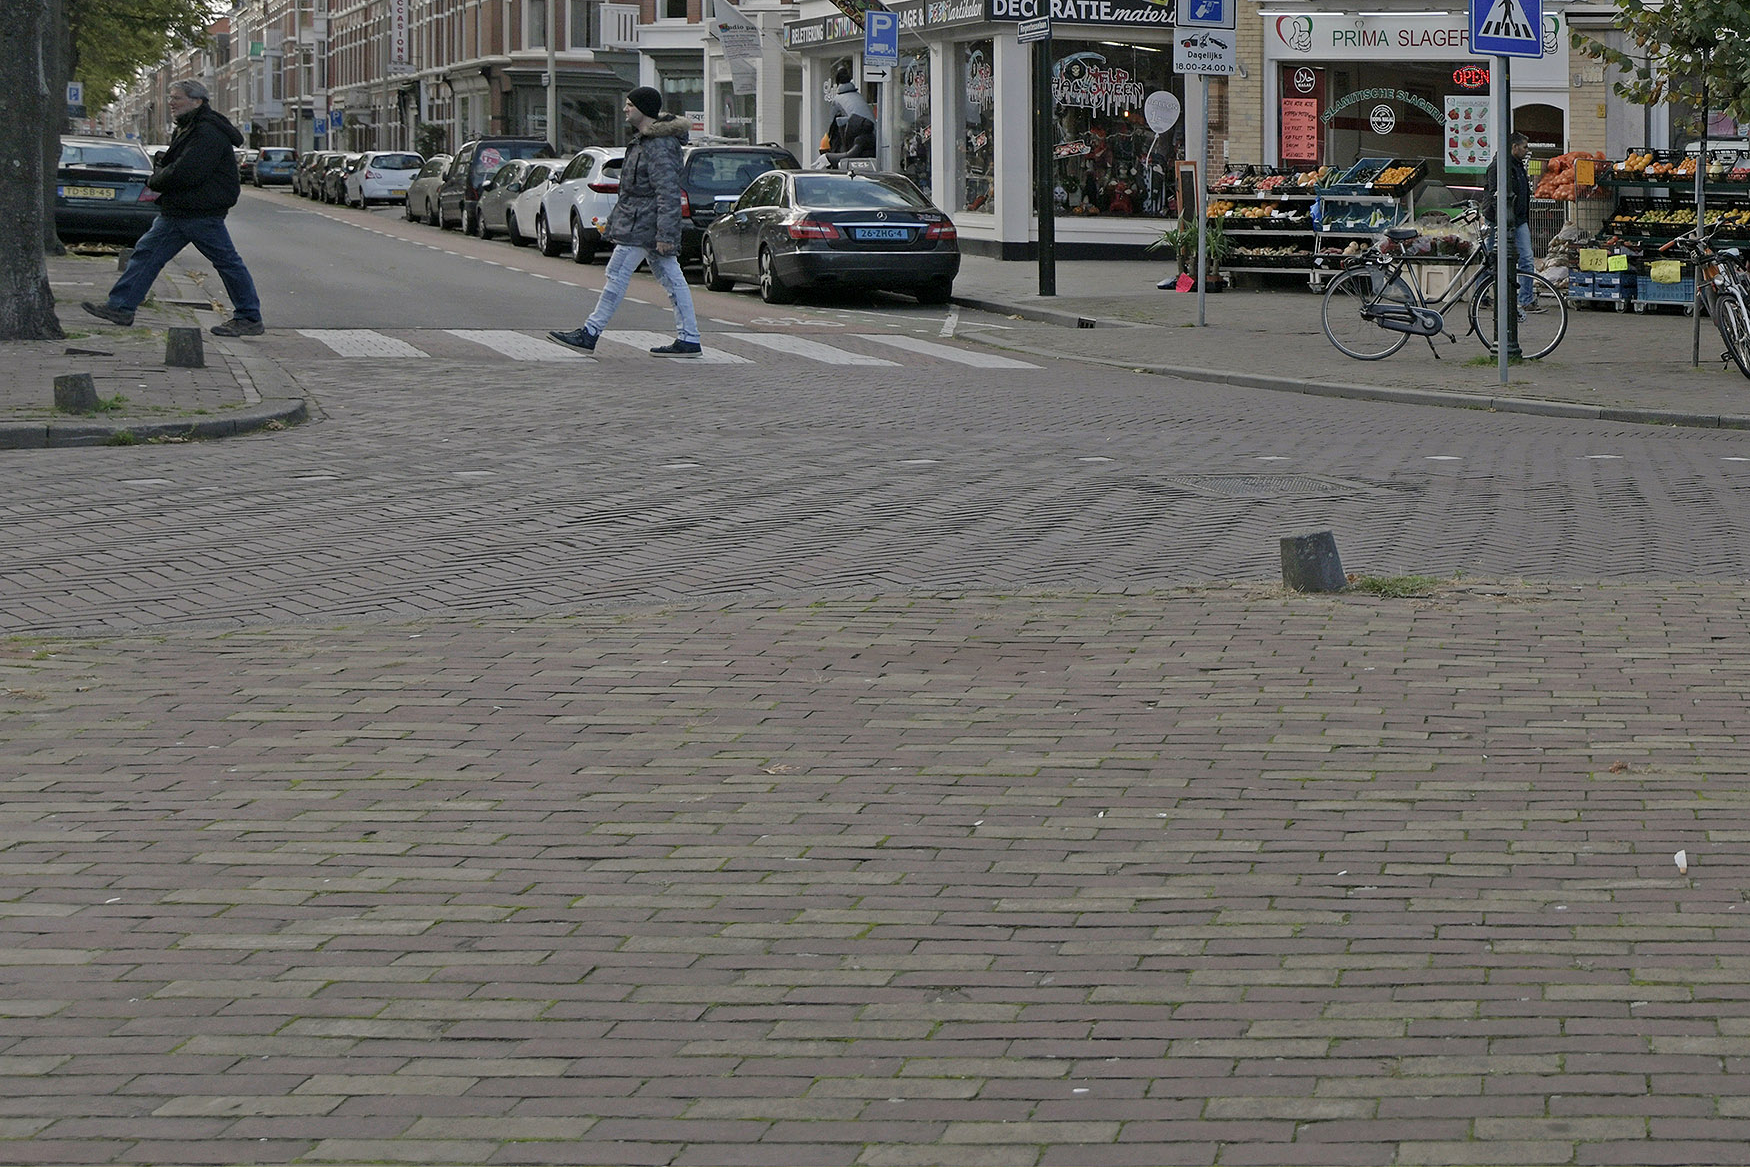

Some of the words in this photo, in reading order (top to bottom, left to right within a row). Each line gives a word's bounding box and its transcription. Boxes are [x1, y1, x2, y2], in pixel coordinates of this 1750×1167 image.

[871, 15, 893, 37] P
[1332, 29, 1390, 47] PRIMA
[1398, 29, 1470, 47] SLAGER
[1187, 51, 1223, 61] Dagelijks
[1175, 63, 1226, 72] 18.00-24.00
[1228, 64, 1234, 72] h
[1452, 69, 1490, 85] OPEN
[1396, 89, 1447, 126] SLAGERIJ
[66, 187, 112, 197] TD-SB-45
[861, 229, 902, 238] 26-ZHG-4
